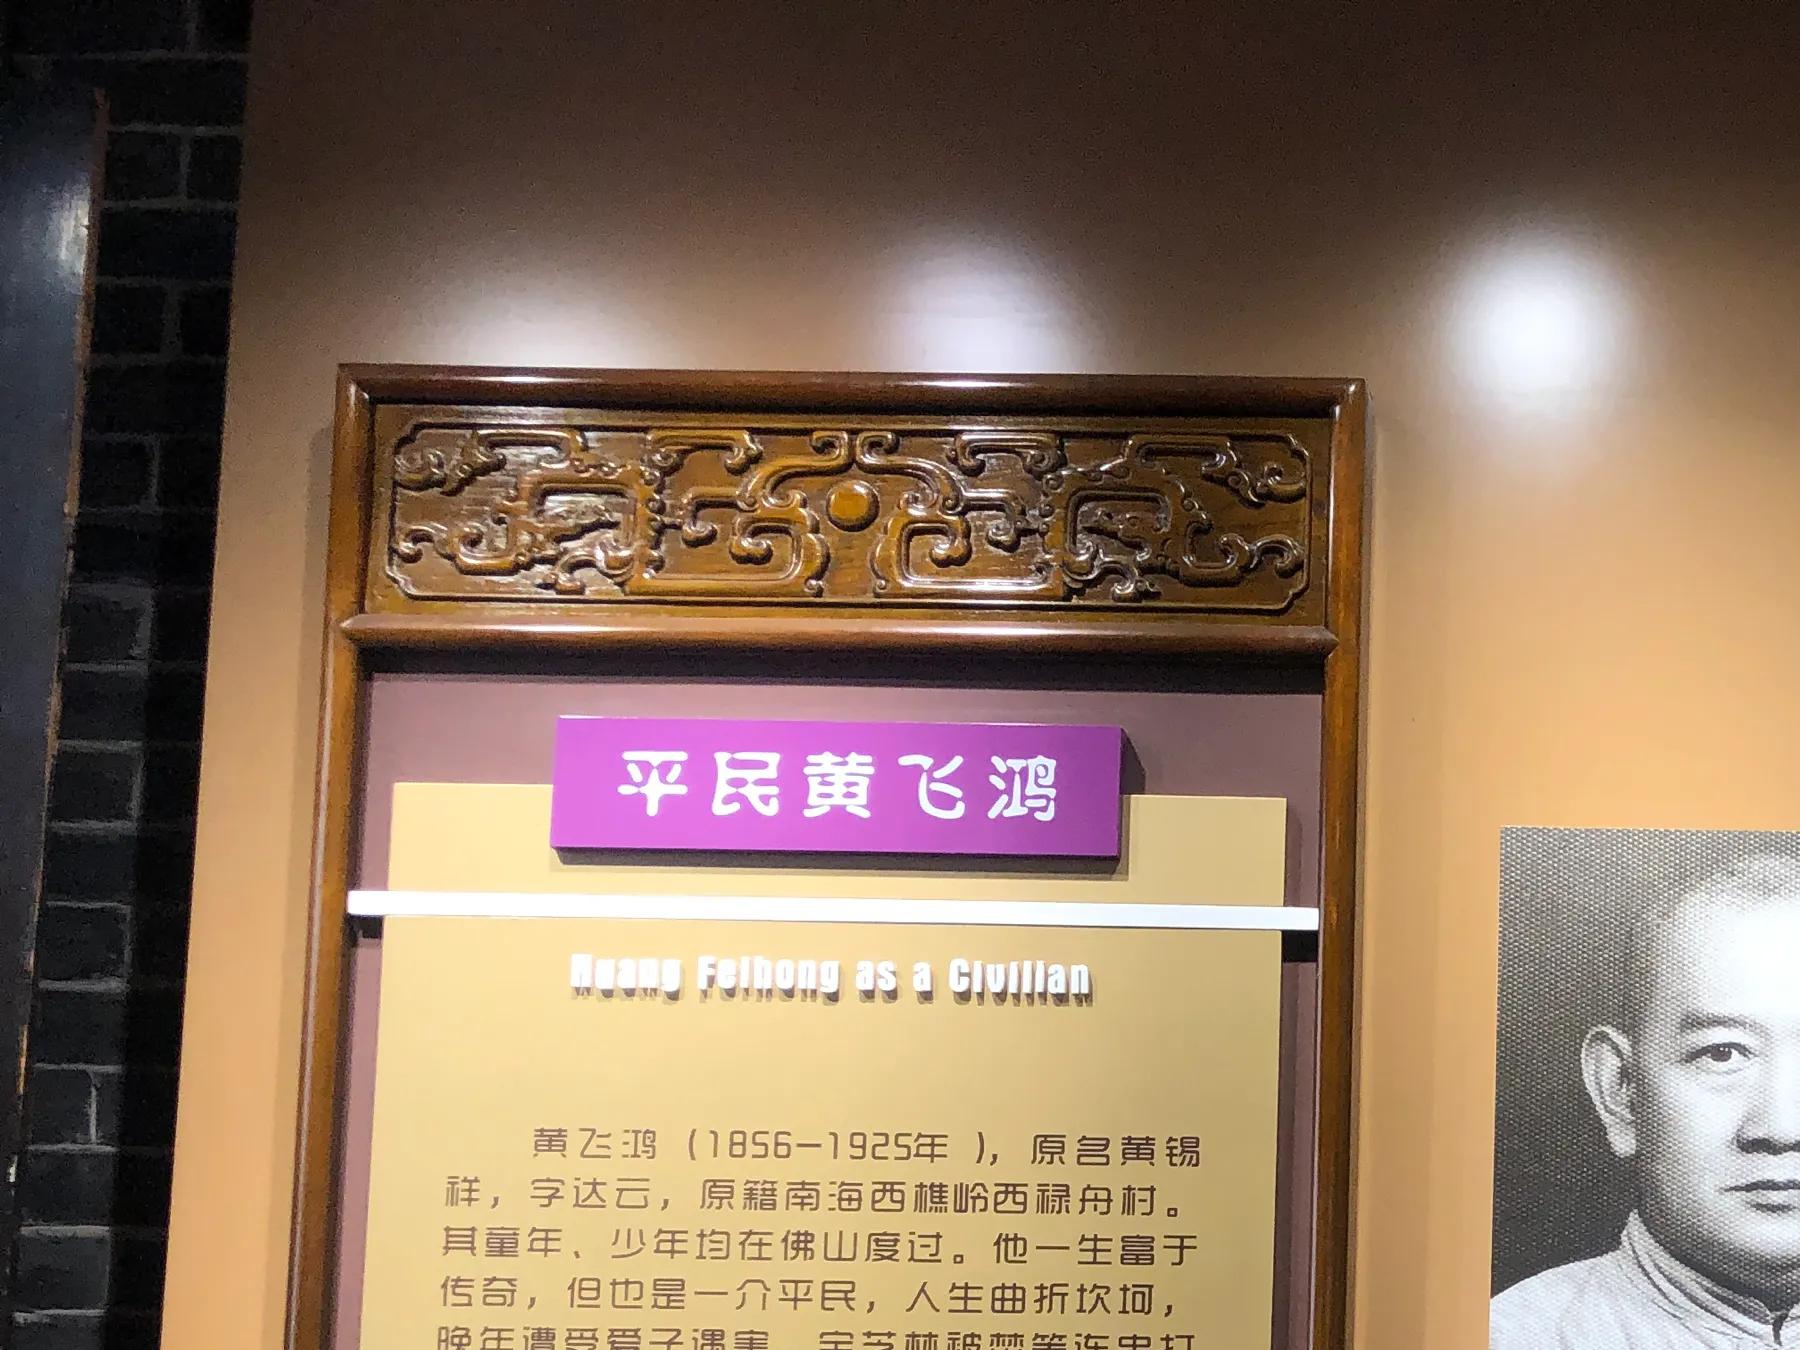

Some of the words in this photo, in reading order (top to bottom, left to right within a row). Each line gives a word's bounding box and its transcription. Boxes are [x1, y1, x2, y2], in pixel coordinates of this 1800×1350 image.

[618, 750, 1057, 822] 平民黄飞鸿
[569, 954, 680, 992] Huang
[698, 956, 839, 992] Feihong
[856, 959, 896, 991] as
[912, 962, 931, 991] a
[949, 958, 1091, 994] Civilian
